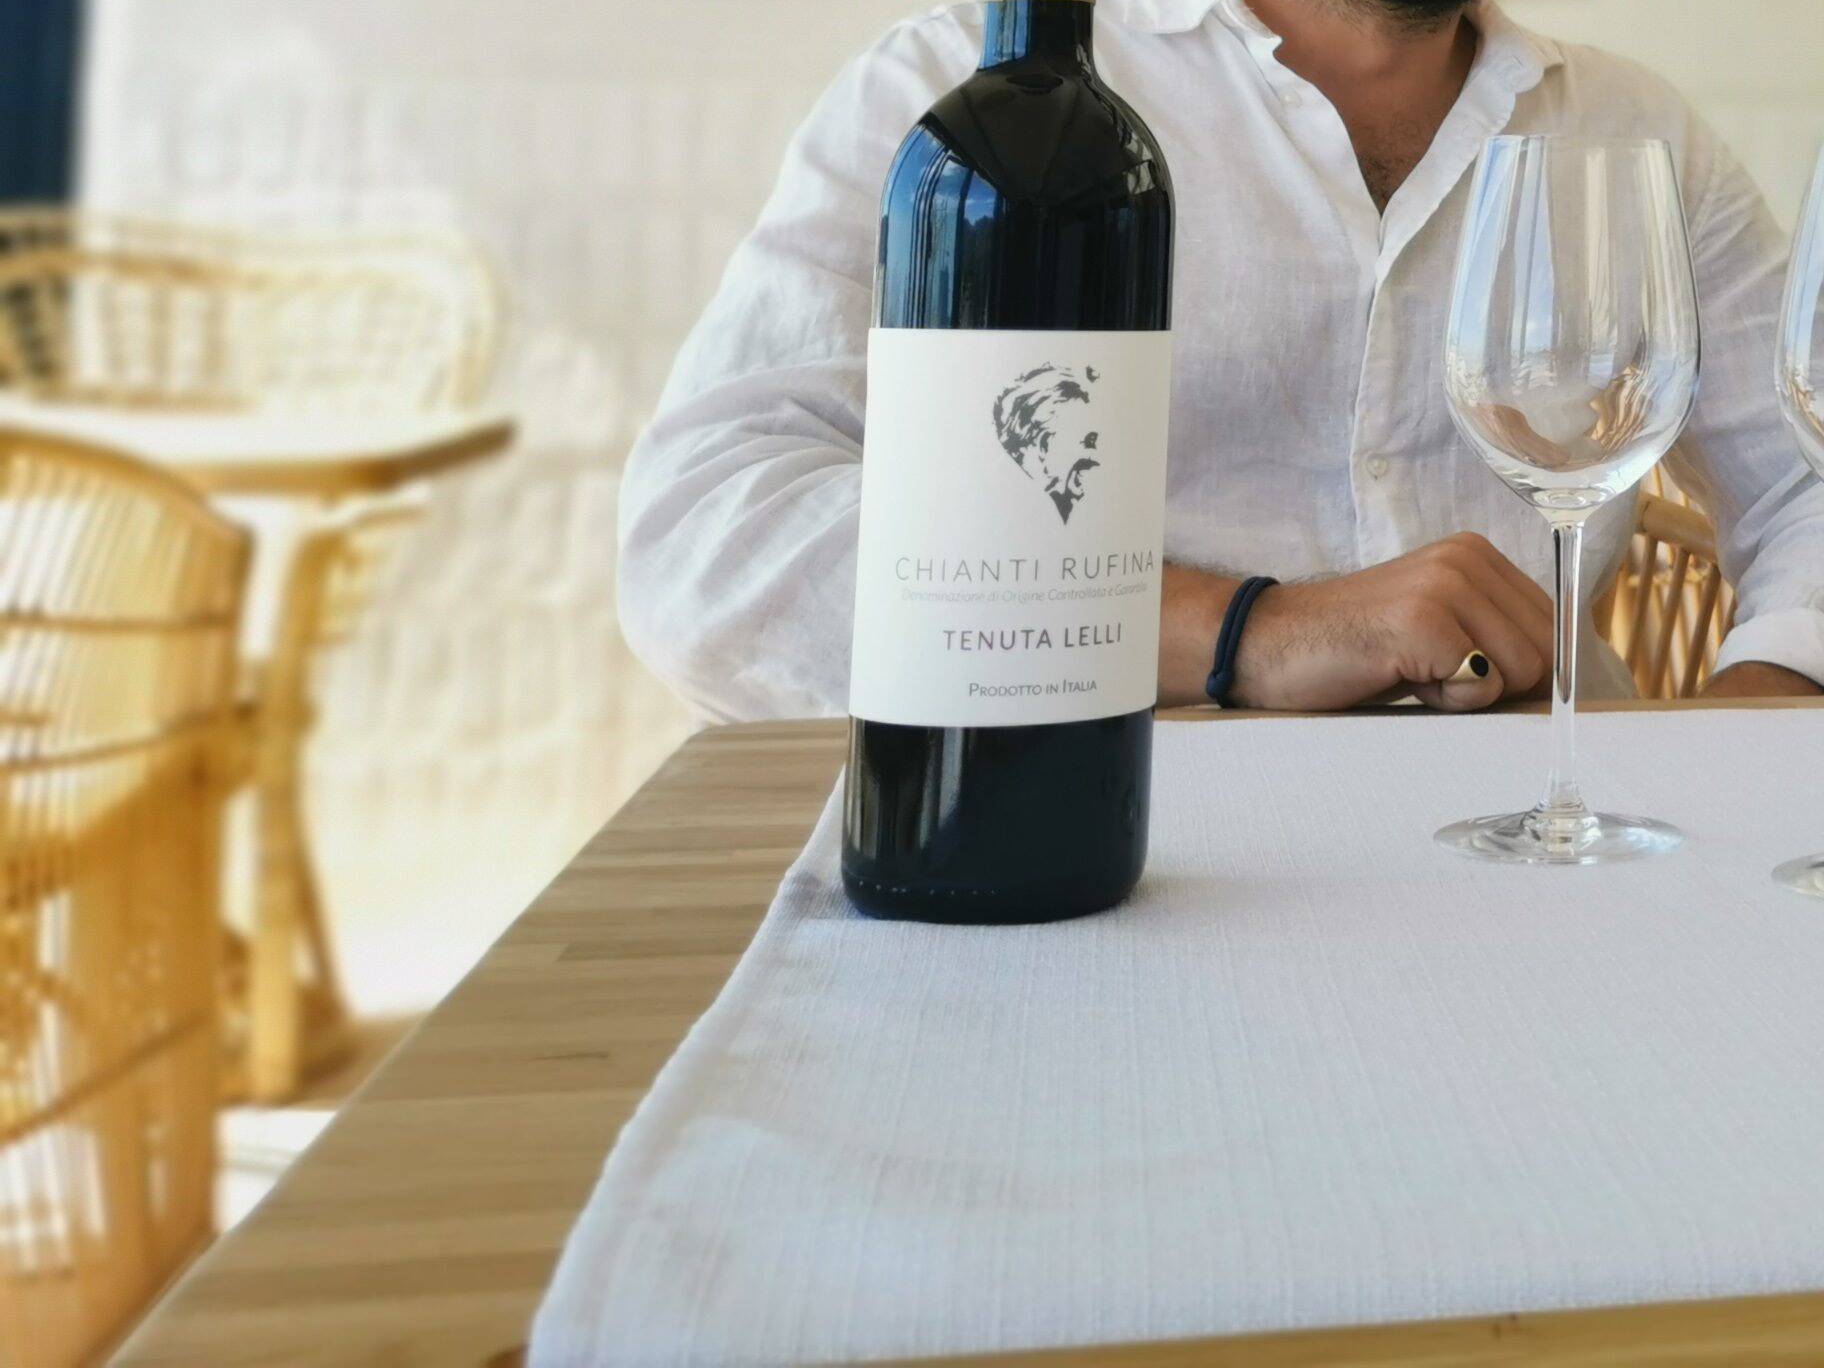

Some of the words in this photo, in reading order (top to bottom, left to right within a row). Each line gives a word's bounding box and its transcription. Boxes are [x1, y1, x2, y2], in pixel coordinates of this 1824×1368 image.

[895, 556, 1039, 583] CHIANTI
[1061, 549, 1155, 581] RUFINA
[1001, 589, 1045, 605] Origine
[942, 628, 1053, 652] TENUTA
[1063, 622, 1122, 649] LELLI
[968, 682, 1043, 698] PRODOTTO
[1045, 684, 1059, 695] IN
[1061, 679, 1098, 694] ITALIA
